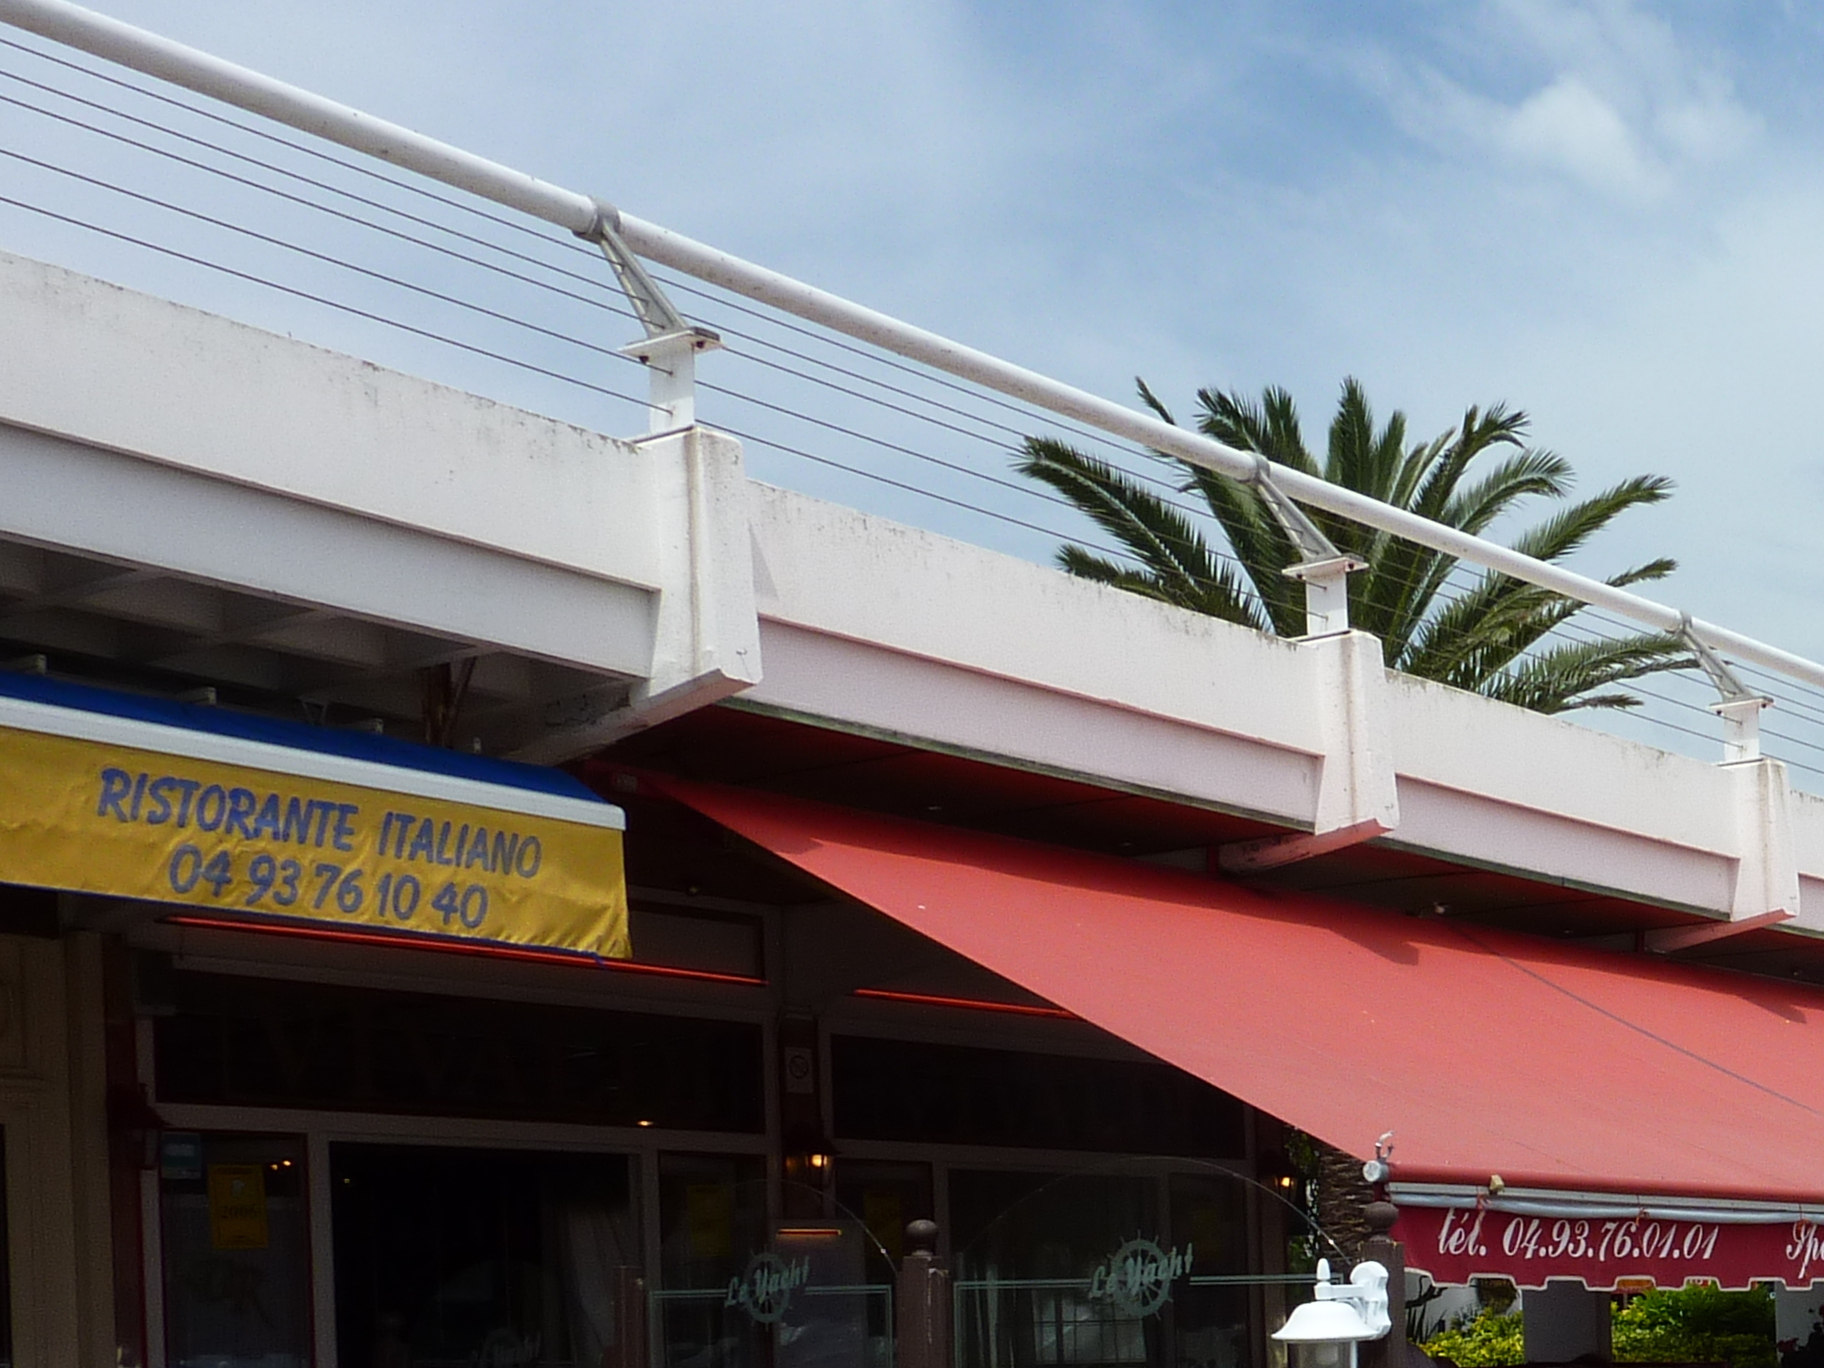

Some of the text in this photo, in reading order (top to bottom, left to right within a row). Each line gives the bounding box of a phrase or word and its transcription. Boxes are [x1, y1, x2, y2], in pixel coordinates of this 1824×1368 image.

[97, 766, 543, 879] RISTORANTE ITALIANO
[168, 844, 489, 930] 04 93 76 10 40
[1437, 1207, 1720, 1262] tél. 04.93.76.01.01
[725, 1257, 810, 1308] Le Yacht
[1088, 1241, 1194, 1300] Le Yacht
